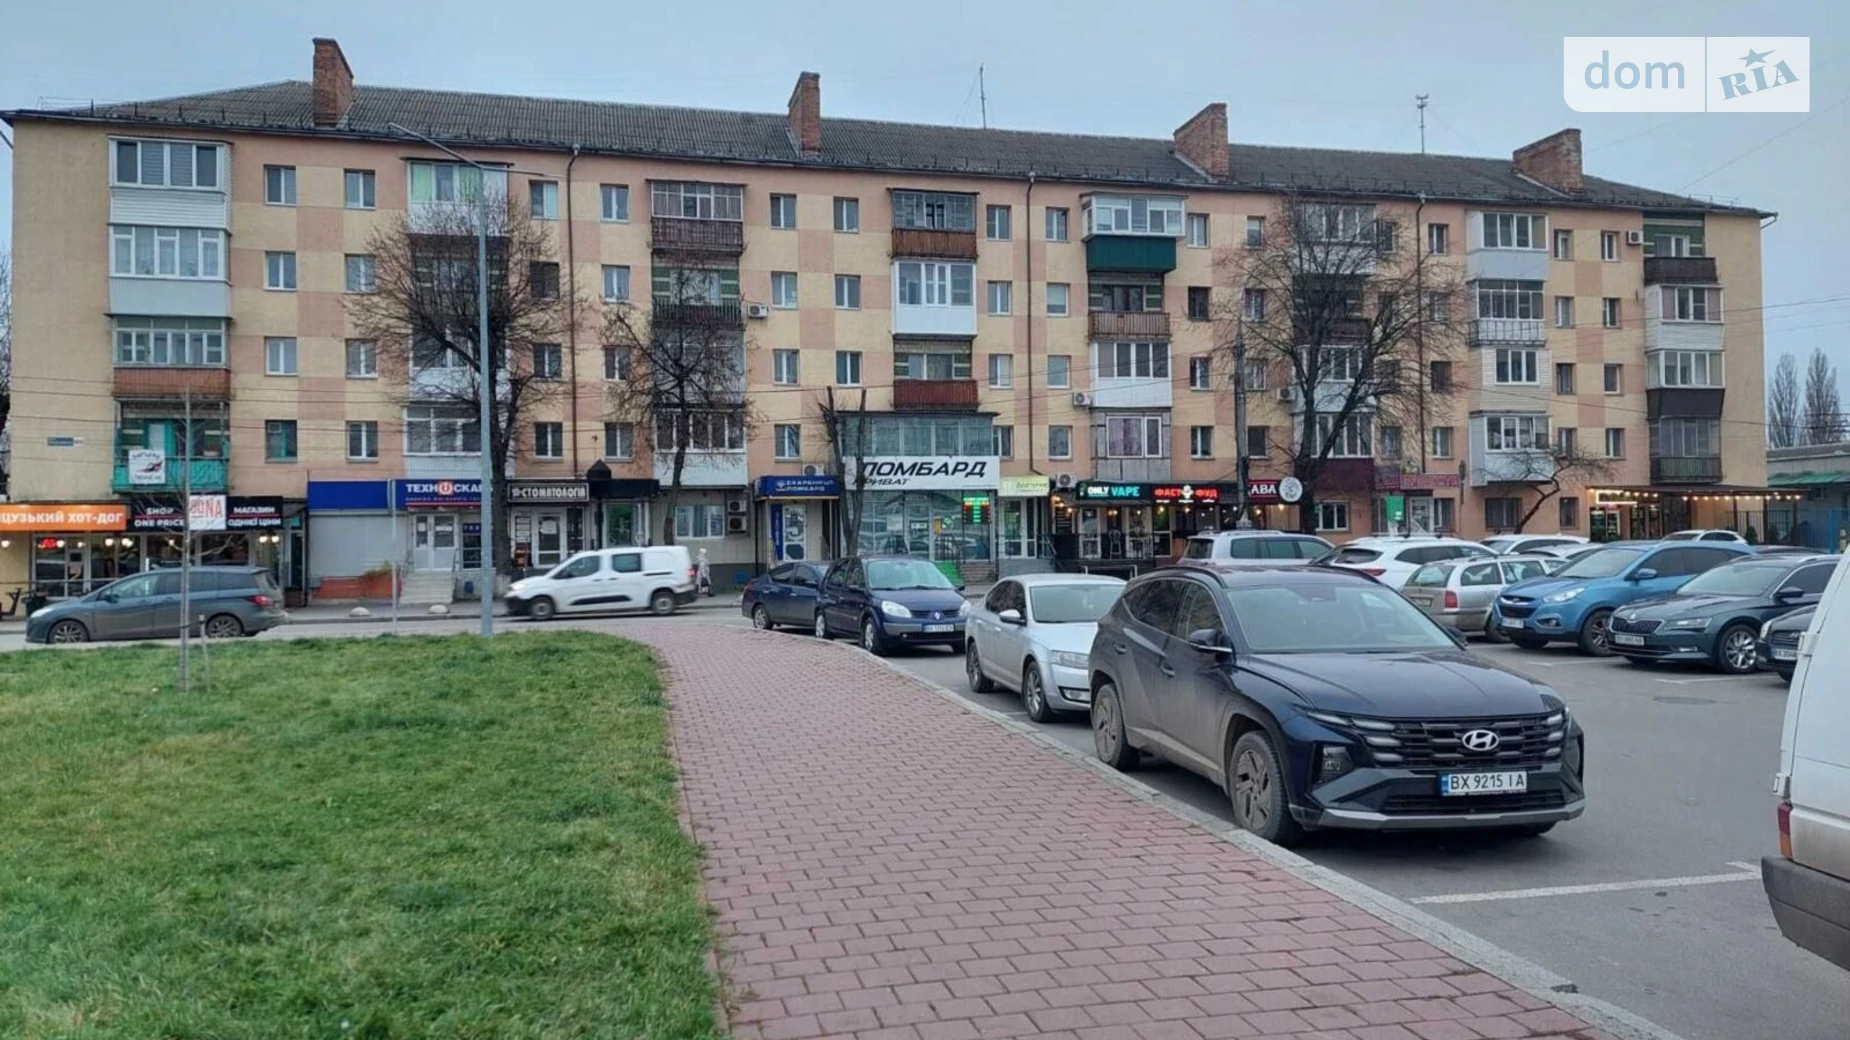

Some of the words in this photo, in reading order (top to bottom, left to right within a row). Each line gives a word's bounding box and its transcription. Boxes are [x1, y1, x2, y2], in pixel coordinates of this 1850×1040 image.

[863, 461, 988, 478] ЛОМБАРД
[406, 482, 493, 495] ТЕХНОСКА
[1087, 486, 1110, 495] ONLY
[1111, 486, 1140, 497] VAPE
[1195, 489, 1218, 499] ФУД
[1248, 484, 1277, 496] АВА
[146, 507, 174, 515] SHOP
[233, 506, 276, 514] МАГАЗИН
[0, 511, 64, 524] ЦУЗЬКИЙ
[68, 512, 123, 525] ХОТ-ДОГ
[134, 519, 155, 527] ONE
[157, 519, 185, 527] PRICE
[259, 518, 282, 527] ЦІНИ
[1451, 775, 1470, 790] BX
[1473, 774, 1503, 789] 9215
[1509, 773, 1524, 787] IA
